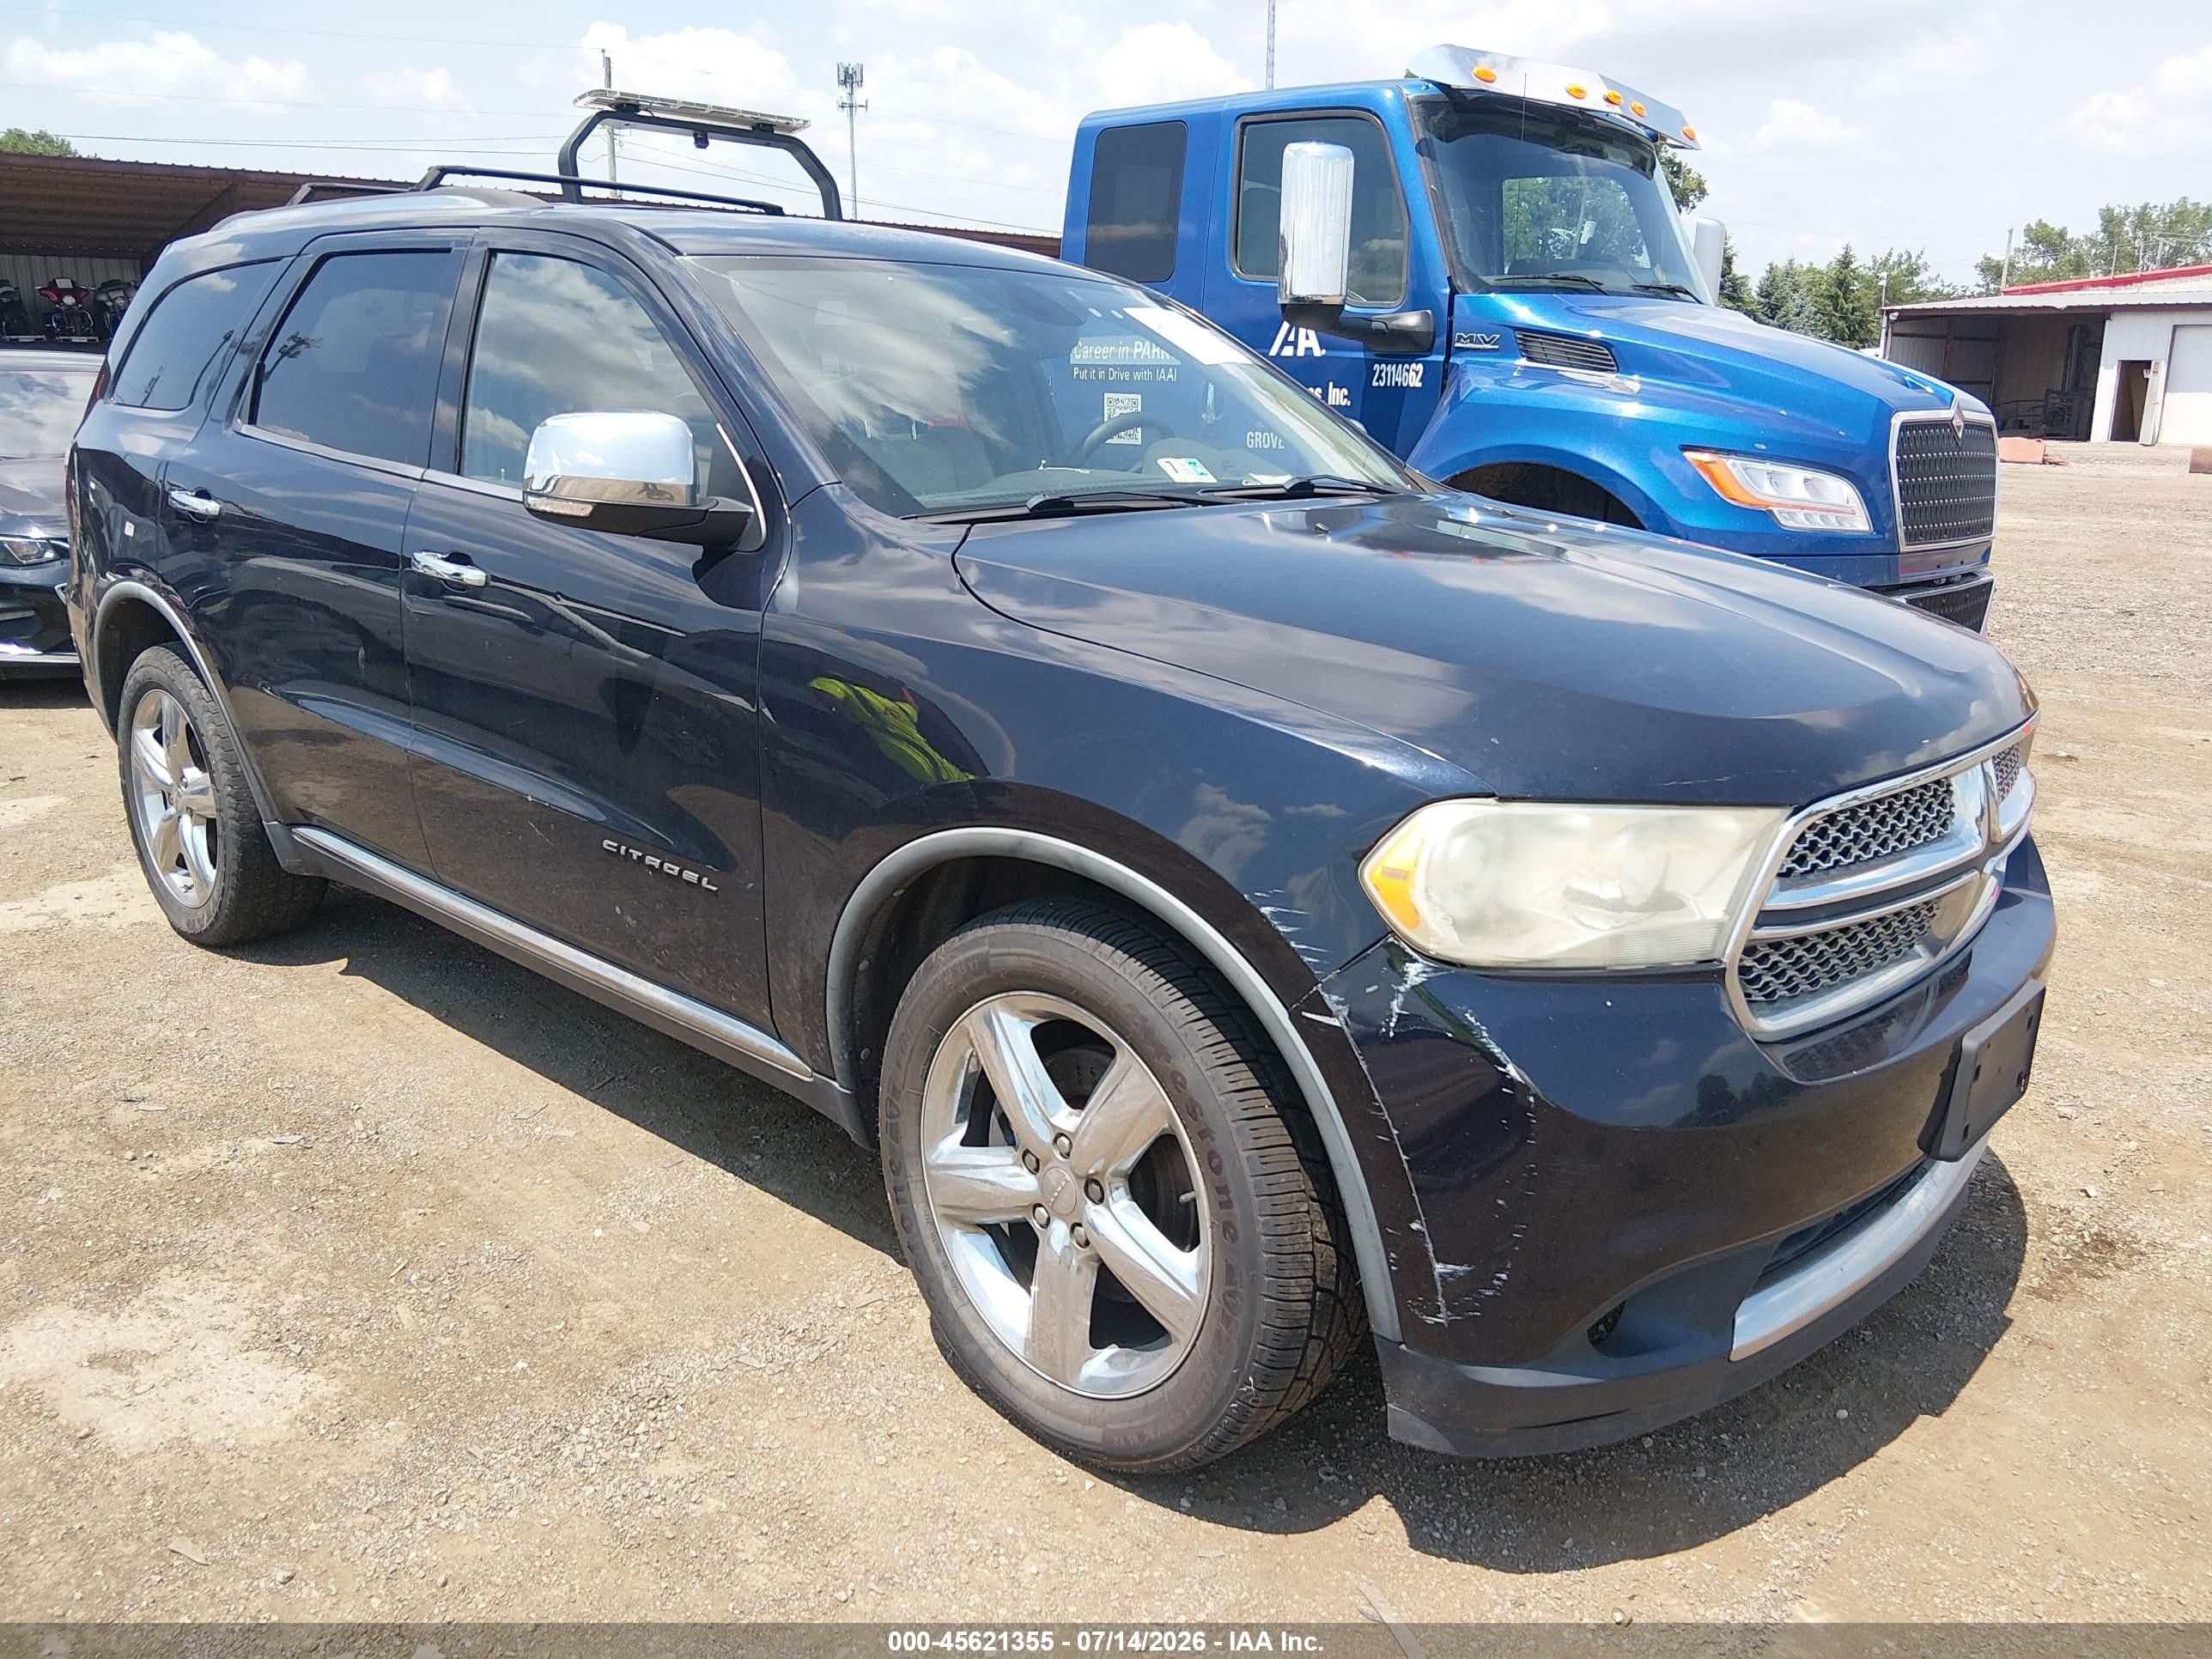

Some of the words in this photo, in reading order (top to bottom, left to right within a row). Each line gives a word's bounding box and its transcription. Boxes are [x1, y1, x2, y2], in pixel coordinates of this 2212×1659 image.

[1455, 332, 1501, 345] MV
[1073, 340, 1115, 360] Career
[1118, 340, 1129, 360] in
[1073, 367, 1088, 380] Put
[1089, 368, 1098, 380] it
[1098, 368, 1105, 380] in
[1108, 368, 1131, 381] Drive
[1133, 368, 1153, 381] with
[1156, 368, 1178, 382] IAAI
[1371, 362, 1425, 388] 23114662
[1328, 381, 1352, 406] Inc.
[601, 838, 720, 893] CITADEL
